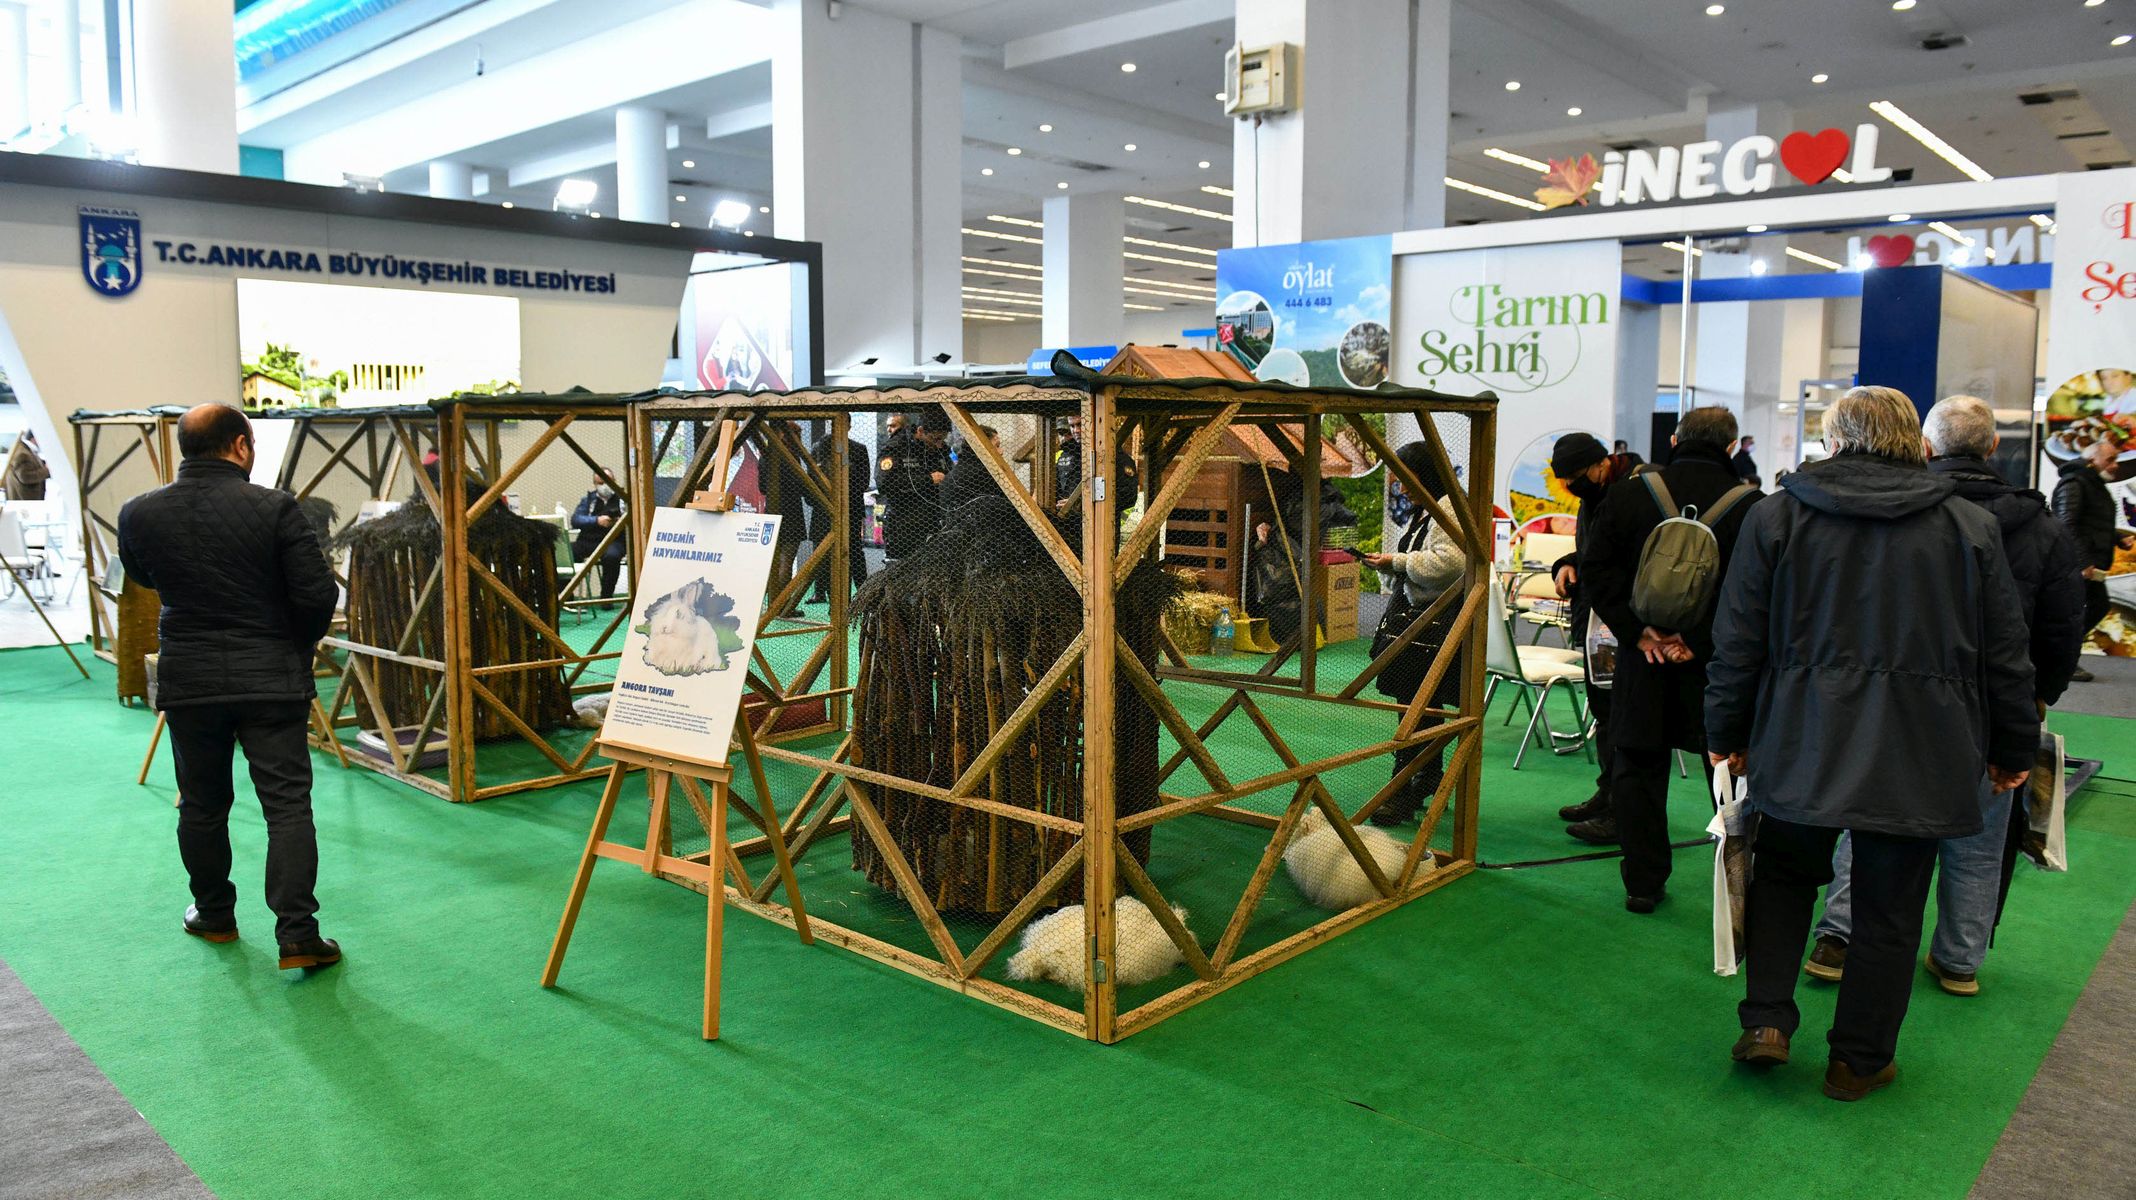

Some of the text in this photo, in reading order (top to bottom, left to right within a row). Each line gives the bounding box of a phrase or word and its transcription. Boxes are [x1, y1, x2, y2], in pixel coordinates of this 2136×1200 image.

[328, 252, 488, 285] BÜYÜKŞEHİR
[493, 268, 616, 294] BELEDİYESİ
[1282, 262, 1334, 296] oylat
[1285, 297, 1332, 308] 444 6 483
[1450, 284, 1608, 328] Tarım
[1417, 329, 1542, 391] Şehri
[656, 531, 696, 544] ENDEMİK
[652, 547, 723, 563] HAYVANLARIMIZ
[621, 681, 675, 697] ANGORA TAVŞANI
